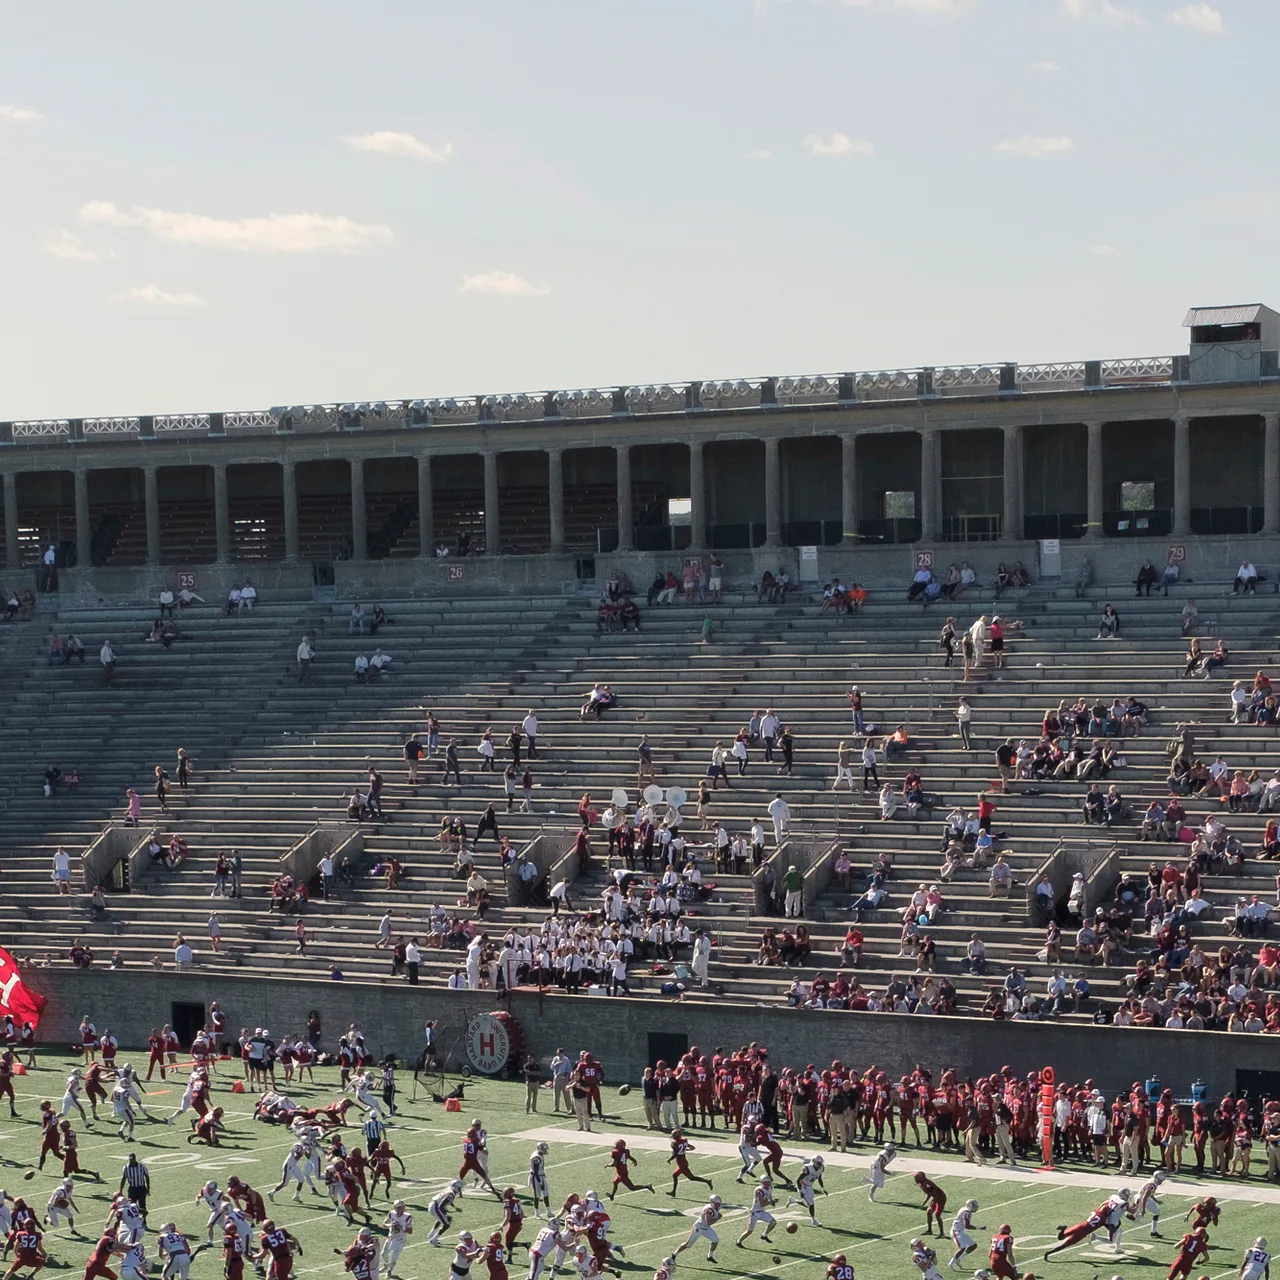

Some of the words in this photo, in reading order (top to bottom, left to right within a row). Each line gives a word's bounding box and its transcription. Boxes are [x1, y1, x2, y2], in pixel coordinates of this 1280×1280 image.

[1170, 547, 1186, 560] 29
[918, 554, 931, 566] 28
[450, 567, 464, 580] 26
[180, 575, 195, 587] 25
[467, 1020, 481, 1060] HARVARD
[480, 1033, 494, 1057] H
[490, 1022, 508, 1065] UNIVERSITY
[478, 1059, 497, 1072] BAND
[584, 1068, 596, 1077] 56
[17, 1210, 29, 1220] 41
[21, 1236, 36, 1248] 52
[269, 1232, 286, 1247] 53
[1254, 1250, 1268, 1262] 27
[836, 1268, 852, 1280] 28
